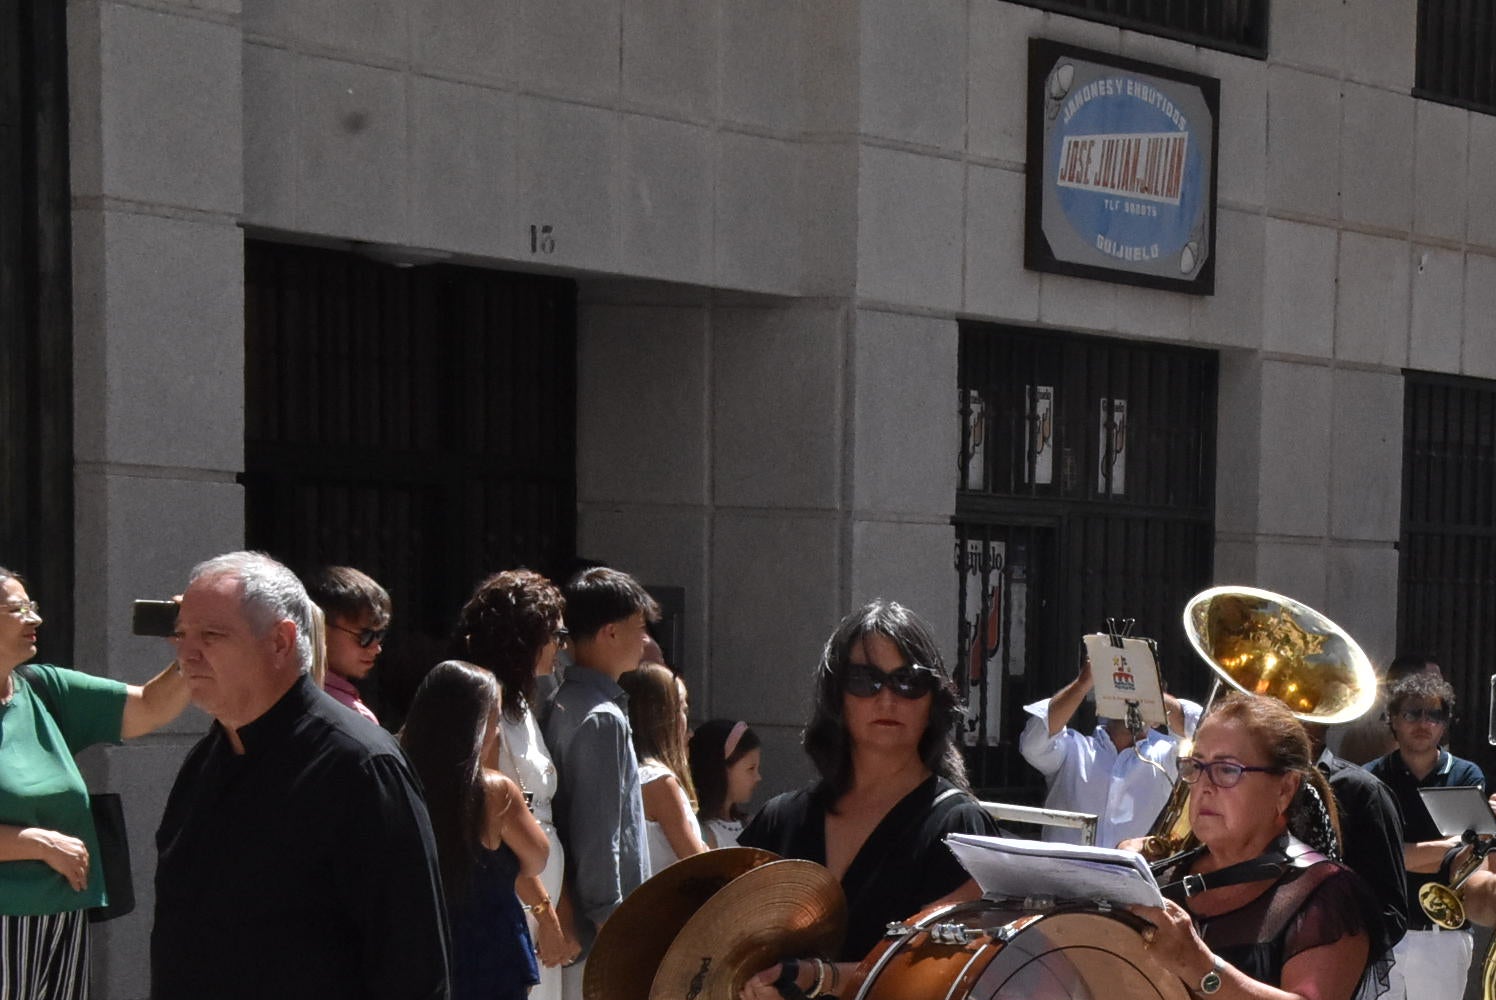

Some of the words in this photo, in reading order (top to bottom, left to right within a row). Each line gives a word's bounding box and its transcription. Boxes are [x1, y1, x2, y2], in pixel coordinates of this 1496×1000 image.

[1115, 79, 1123, 95] Y
[1059, 140, 1095, 184] JOSE
[1096, 233, 1159, 261] GUIJUELO
